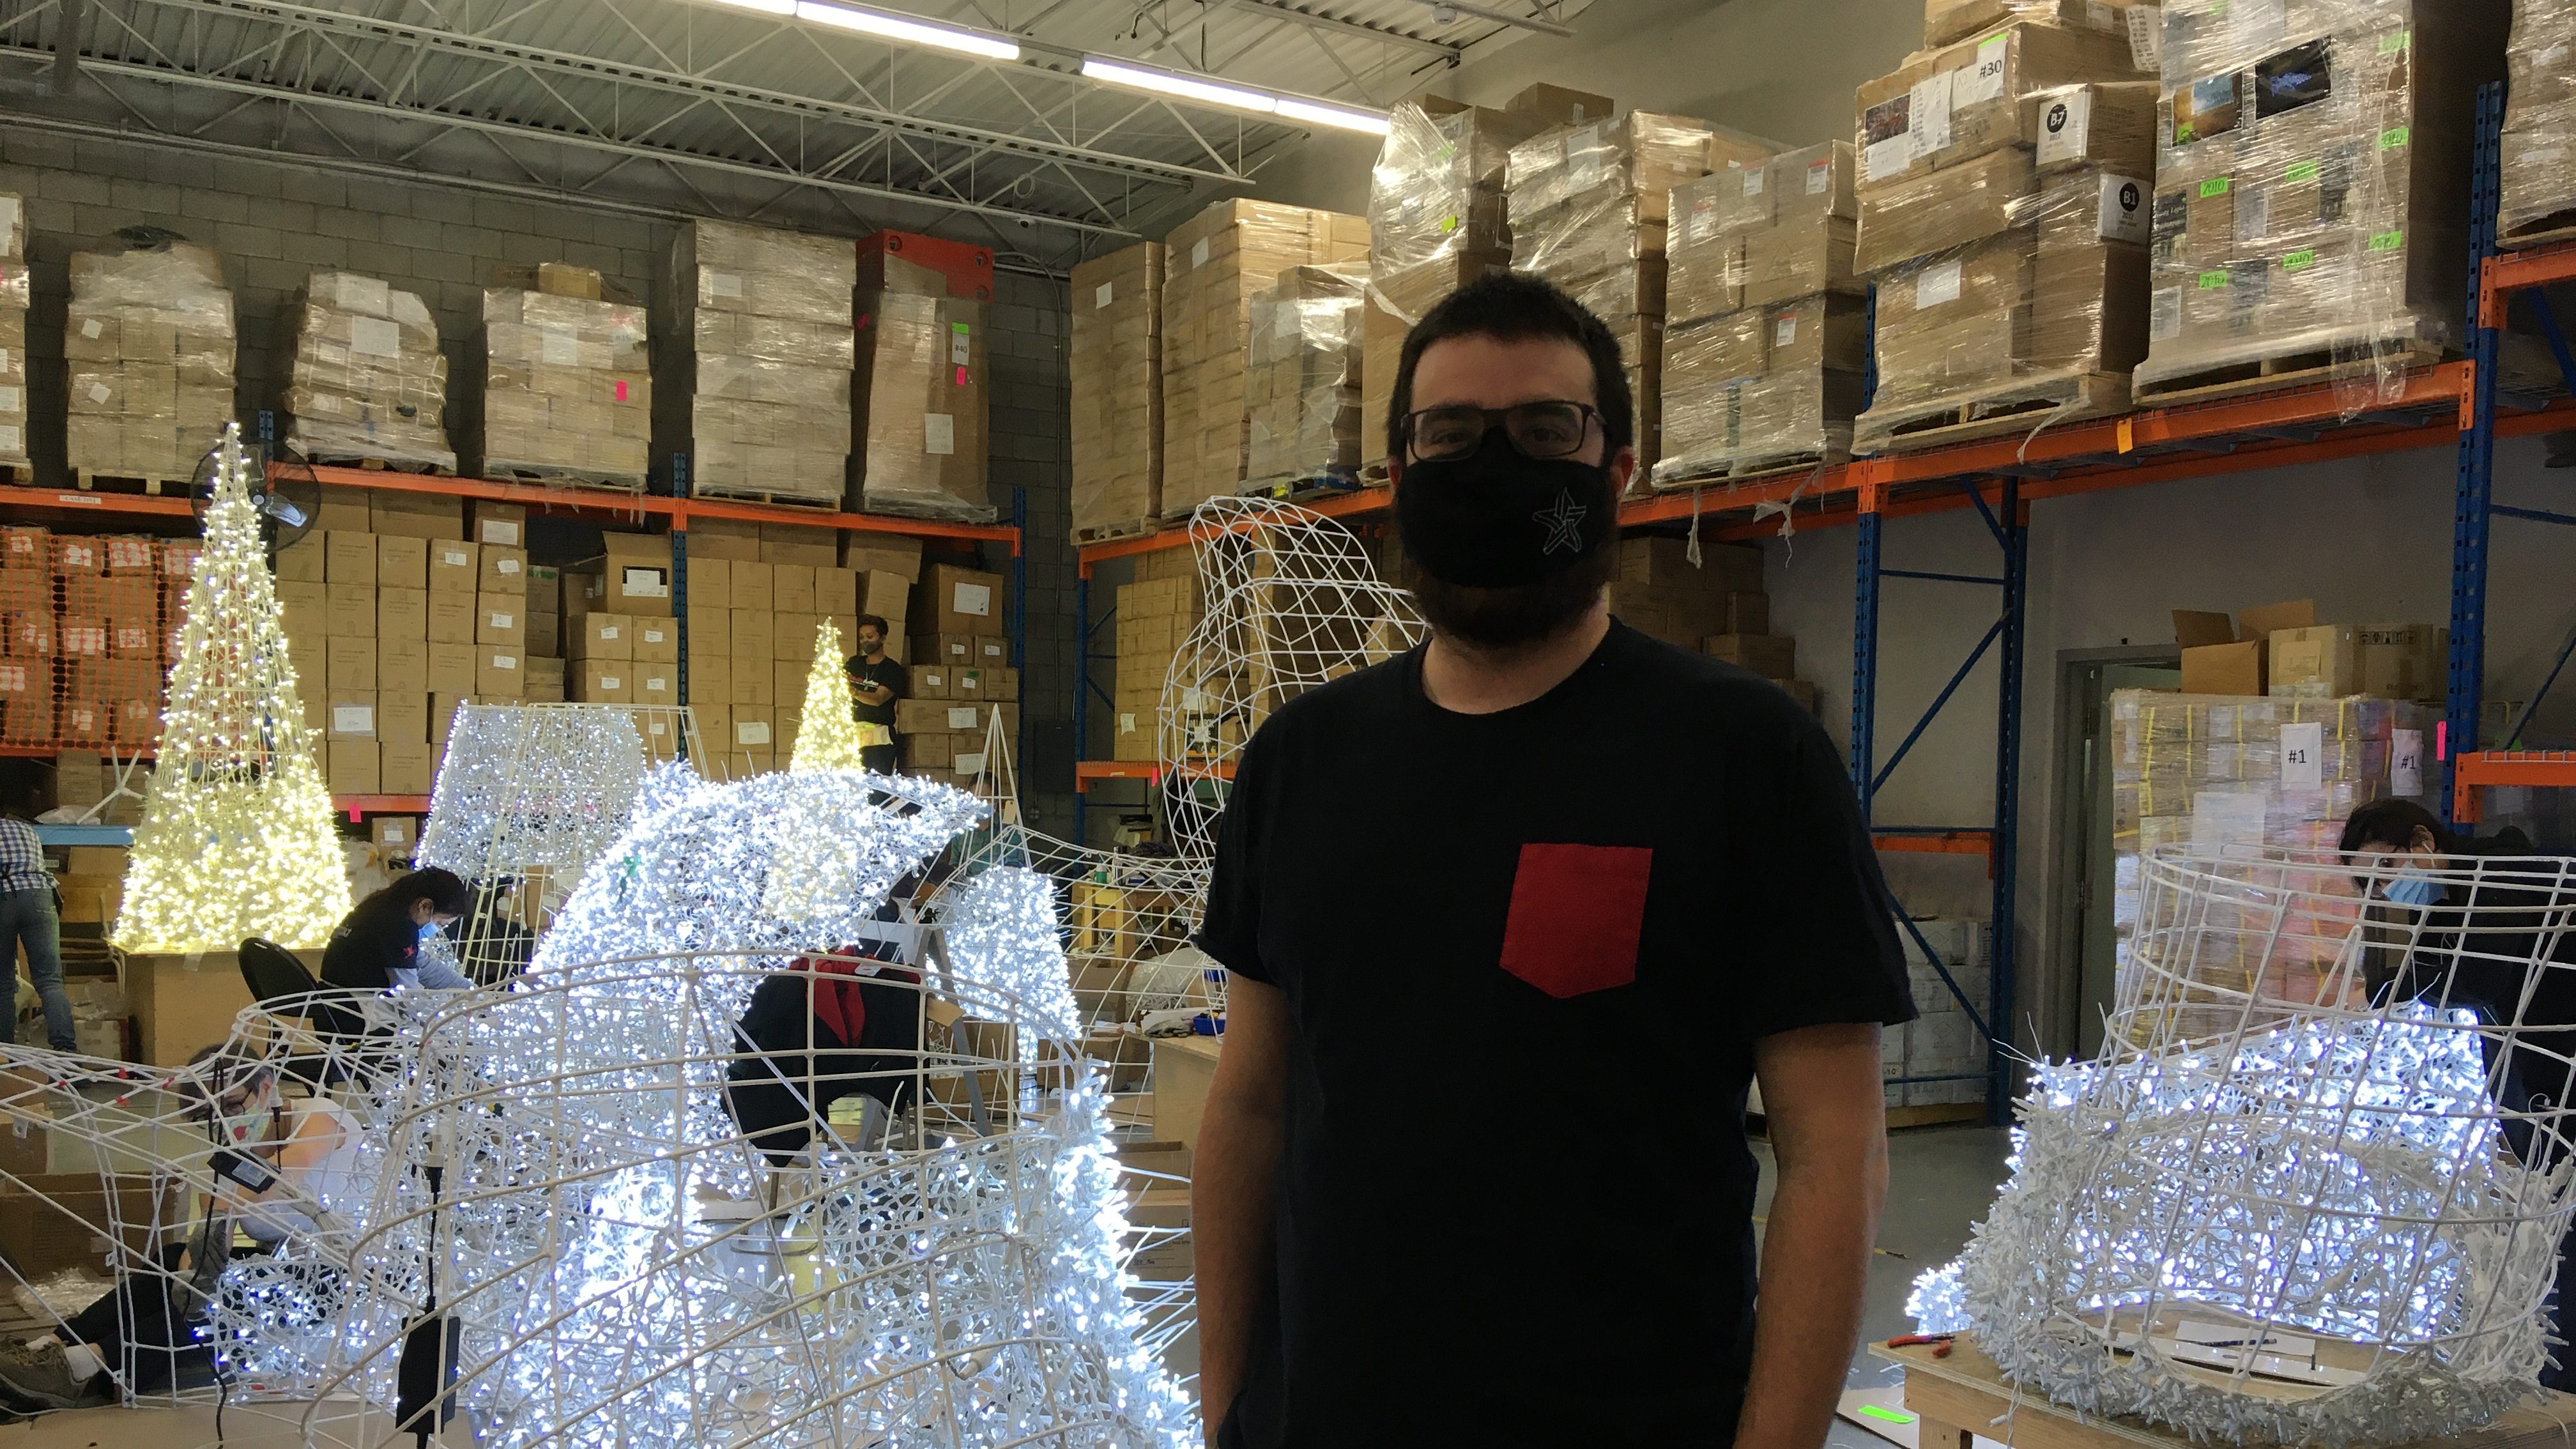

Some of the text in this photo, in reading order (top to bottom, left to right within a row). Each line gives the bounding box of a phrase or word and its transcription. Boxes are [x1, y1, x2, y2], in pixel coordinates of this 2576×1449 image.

[1979, 59, 2002, 79] #30
[2050, 110, 2065, 126] B7
[2202, 180, 2225, 195] 2010
[2123, 190, 2136, 205] B1
[955, 344, 967, 353] #40
[2288, 749, 2307, 764] #1
[2400, 755, 2416, 769] #1
